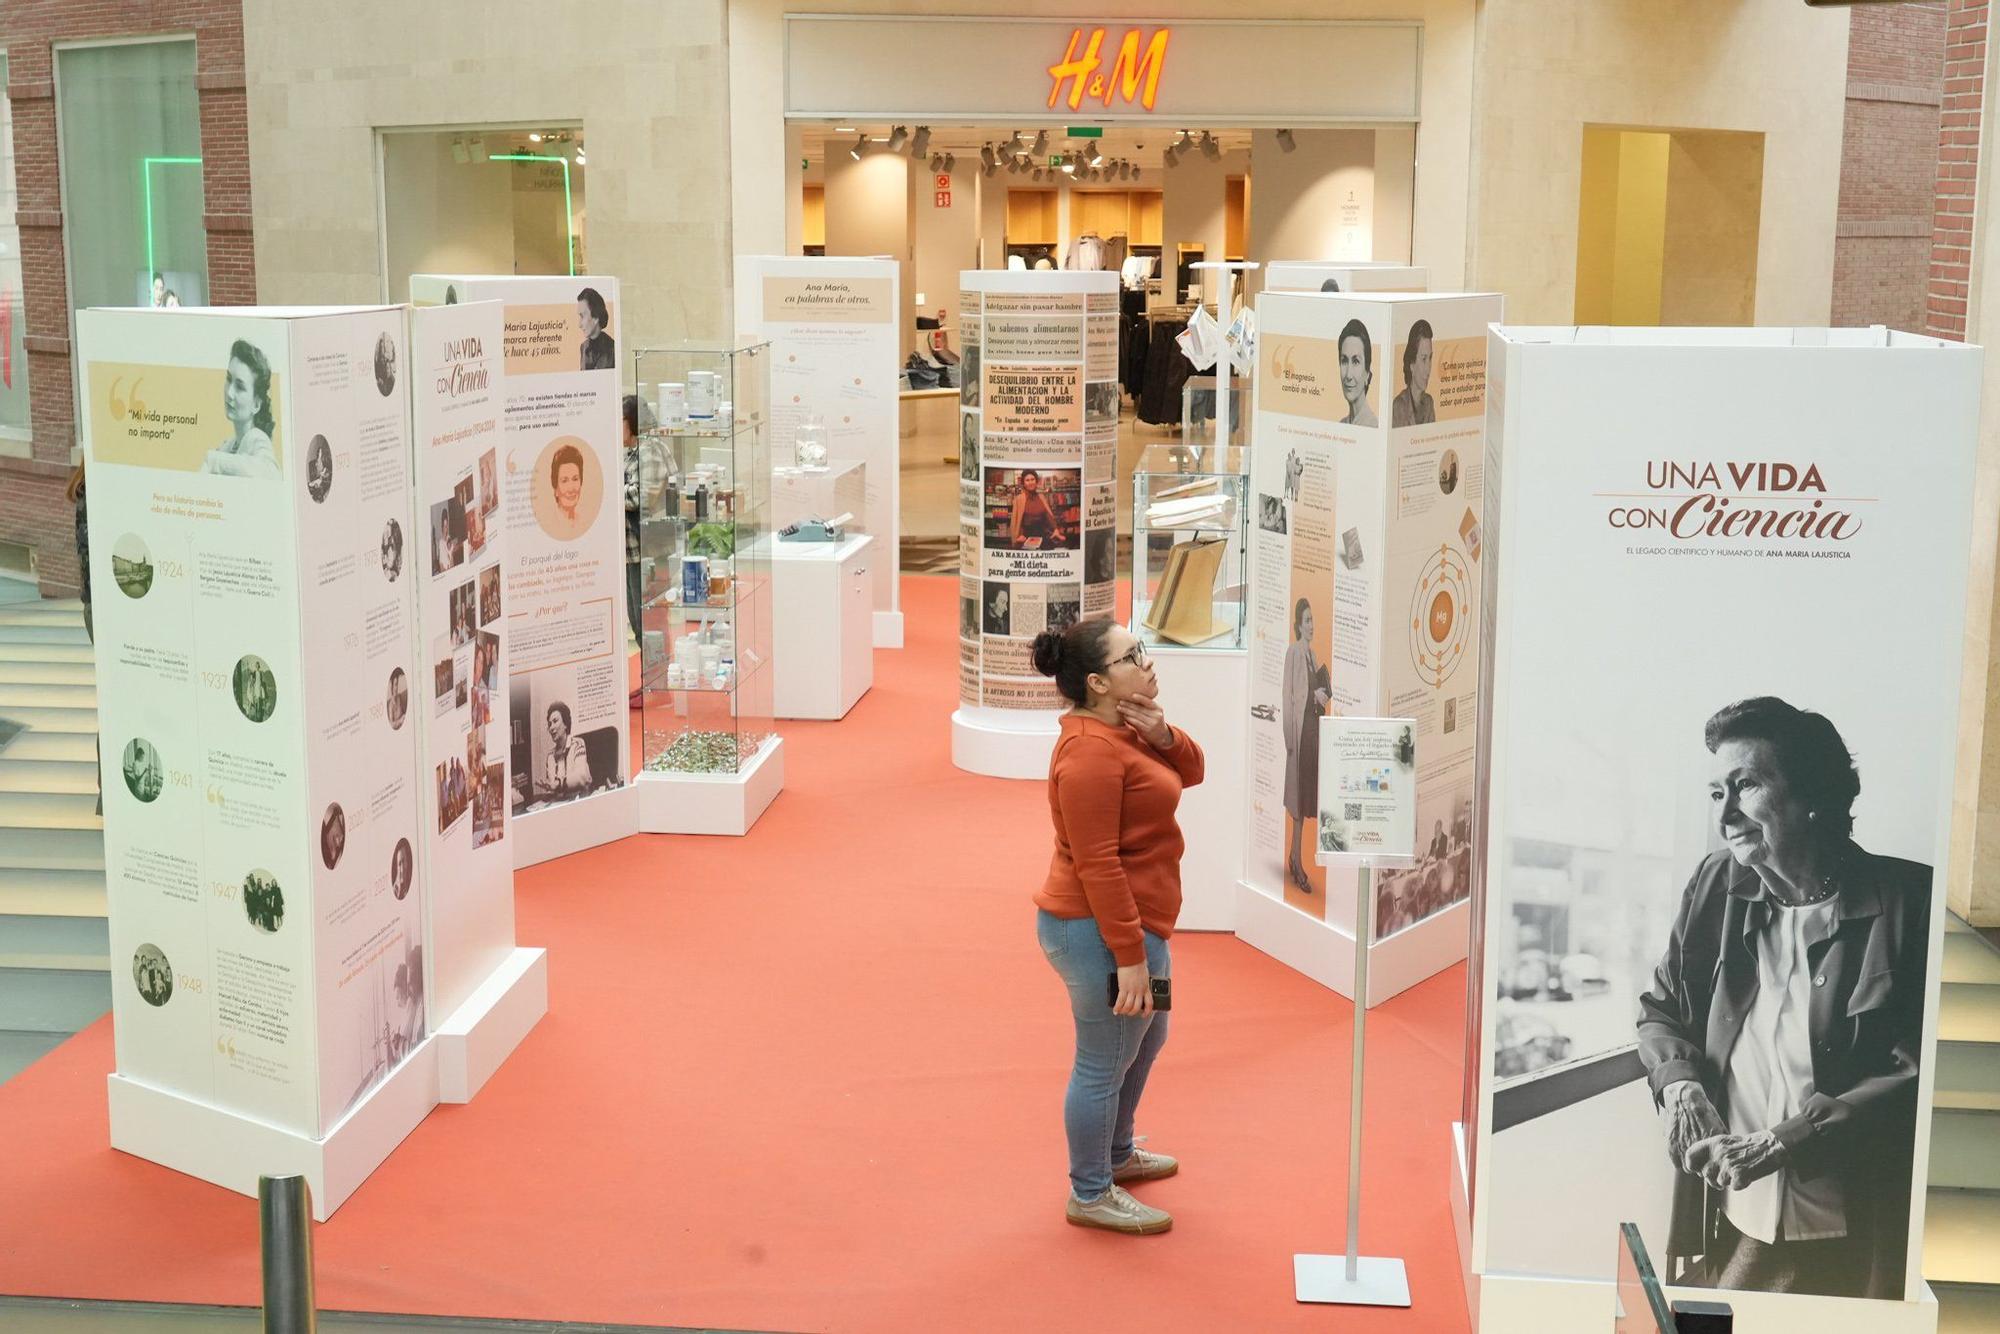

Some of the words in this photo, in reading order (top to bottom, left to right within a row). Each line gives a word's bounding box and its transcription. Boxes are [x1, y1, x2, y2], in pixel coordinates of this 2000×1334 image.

[1048, 27, 1169, 111] H&M
[805, 283, 822, 292] Ana
[824, 283, 851, 293] María,
[796, 294, 834, 305] palabras
[835, 294, 846, 303] de
[847, 296, 872, 304] otros.
[985, 303, 1018, 312] Adelgazar
[1032, 304, 1054, 312] pasar
[1055, 302, 1083, 311] hambre
[988, 322, 996, 333] No
[1000, 322, 1029, 333] sabemos
[1033, 323, 1079, 334] alimentarnos
[504, 336, 527, 345] marca
[529, 333, 562, 344] referente
[988, 337, 1015, 346] Desayunar
[444, 341, 462, 362] UNA
[461, 337, 483, 359] VIDA
[511, 345, 529, 357] hace
[436, 378, 451, 394] CON
[450, 359, 489, 398] Ciencia
[989, 375, 1038, 385] DESEQUILIBRIO
[1042, 375, 1064, 385] ENTRE
[1067, 375, 1076, 385] LA
[998, 386, 1049, 395] ALIMENTACION
[1053, 386, 1058, 395] Y
[1060, 386, 1069, 395] LA
[1456, 383, 1475, 393] estudiar
[535, 394, 554, 402] existen
[554, 392, 573, 400] tiendas
[579, 391, 597, 399] marcas
[990, 395, 1024, 405] ACTIVIDAD
[1028, 396, 1041, 405] DEL
[1044, 396, 1074, 405] HOMBRE
[1015, 406, 1050, 415] MODERNO
[143, 410, 161, 423] vida
[163, 414, 198, 426] personal
[1004, 416, 1021, 424] España
[1032, 417, 1055, 425] desayuna
[128, 428, 138, 437] no
[140, 427, 175, 440] importa”
[519, 423, 531, 432] para
[984, 436, 996, 444] Ana
[1647, 460, 1722, 490] UNA
[1726, 461, 1827, 492] VIDA
[164, 506, 171, 515] de
[172, 508, 186, 517] miles
[187, 509, 194, 518] de
[1608, 508, 1667, 529] CON
[1670, 493, 1863, 541] Ciencia
[521, 556, 527, 566] El
[528, 553, 552, 565] porqué
[553, 550, 564, 561] del
[564, 549, 579, 560] logo
[1627, 547, 1634, 555] EL
[1636, 547, 1667, 556] LEGADO
[1710, 549, 1715, 557] Y
[1717, 549, 1753, 557] HUMANO
[1755, 550, 1764, 558] DE
[1766, 550, 1783, 558] ANA
[1785, 550, 1809, 558] MARIA
[1811, 551, 1851, 559] LAJUSTICIA
[158, 560, 184, 578] 1924
[1026, 561, 1048, 569] dieta
[988, 569, 1004, 577] para
[1005, 569, 1026, 578] gente
[1436, 610, 1447, 624] Mg
[201, 671, 228, 690] 1937
[990, 688, 1014, 697] ARTROSIS
[1016, 689, 1026, 697] NO
[1027, 689, 1034, 697] ES
[169, 770, 193, 788] 1941
[212, 881, 239, 898] 1947
[178, 973, 202, 993] 1948
